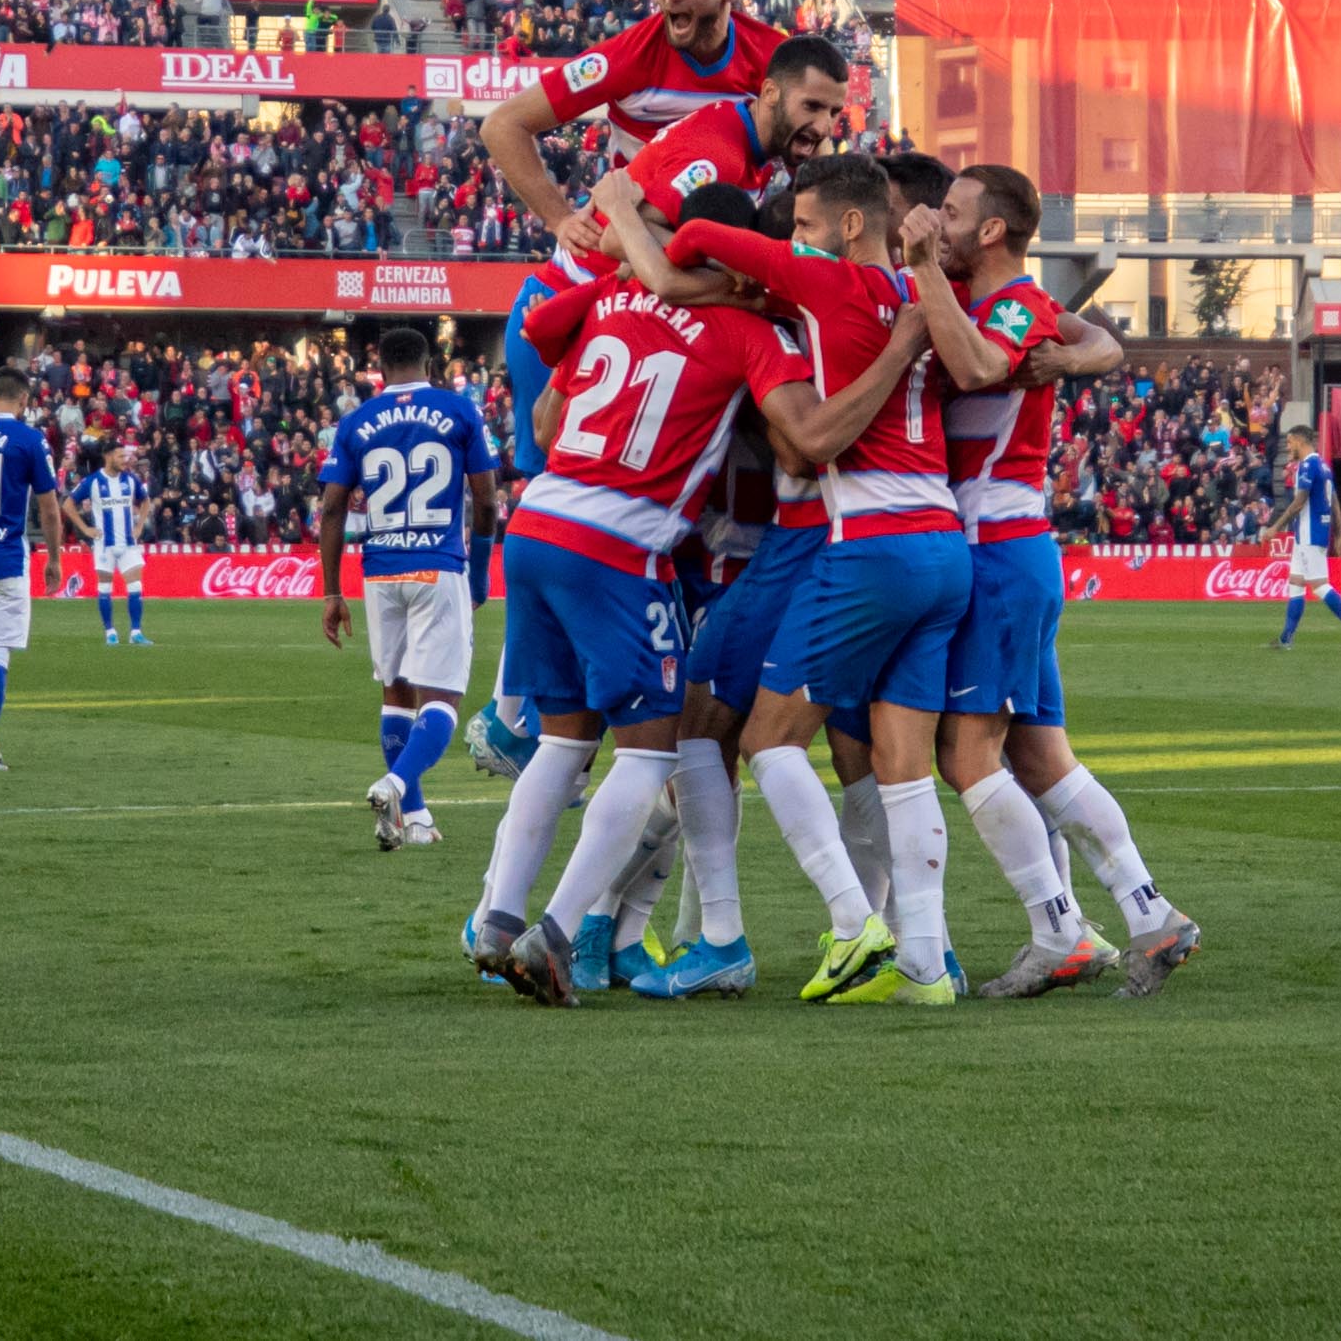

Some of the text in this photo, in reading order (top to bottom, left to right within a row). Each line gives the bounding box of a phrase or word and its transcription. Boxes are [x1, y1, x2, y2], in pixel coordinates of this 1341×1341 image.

[161, 53, 294, 84] IDEAL
[47, 264, 182, 296] PULEVA
[375, 266, 447, 283] CERVEZAS
[371, 287, 452, 304] ALHAMBRA
[555, 335, 687, 472] 21
[357, 406, 454, 441] M.WAKASO
[363, 441, 452, 532] 22
[201, 556, 321, 596] Coca-Cola
